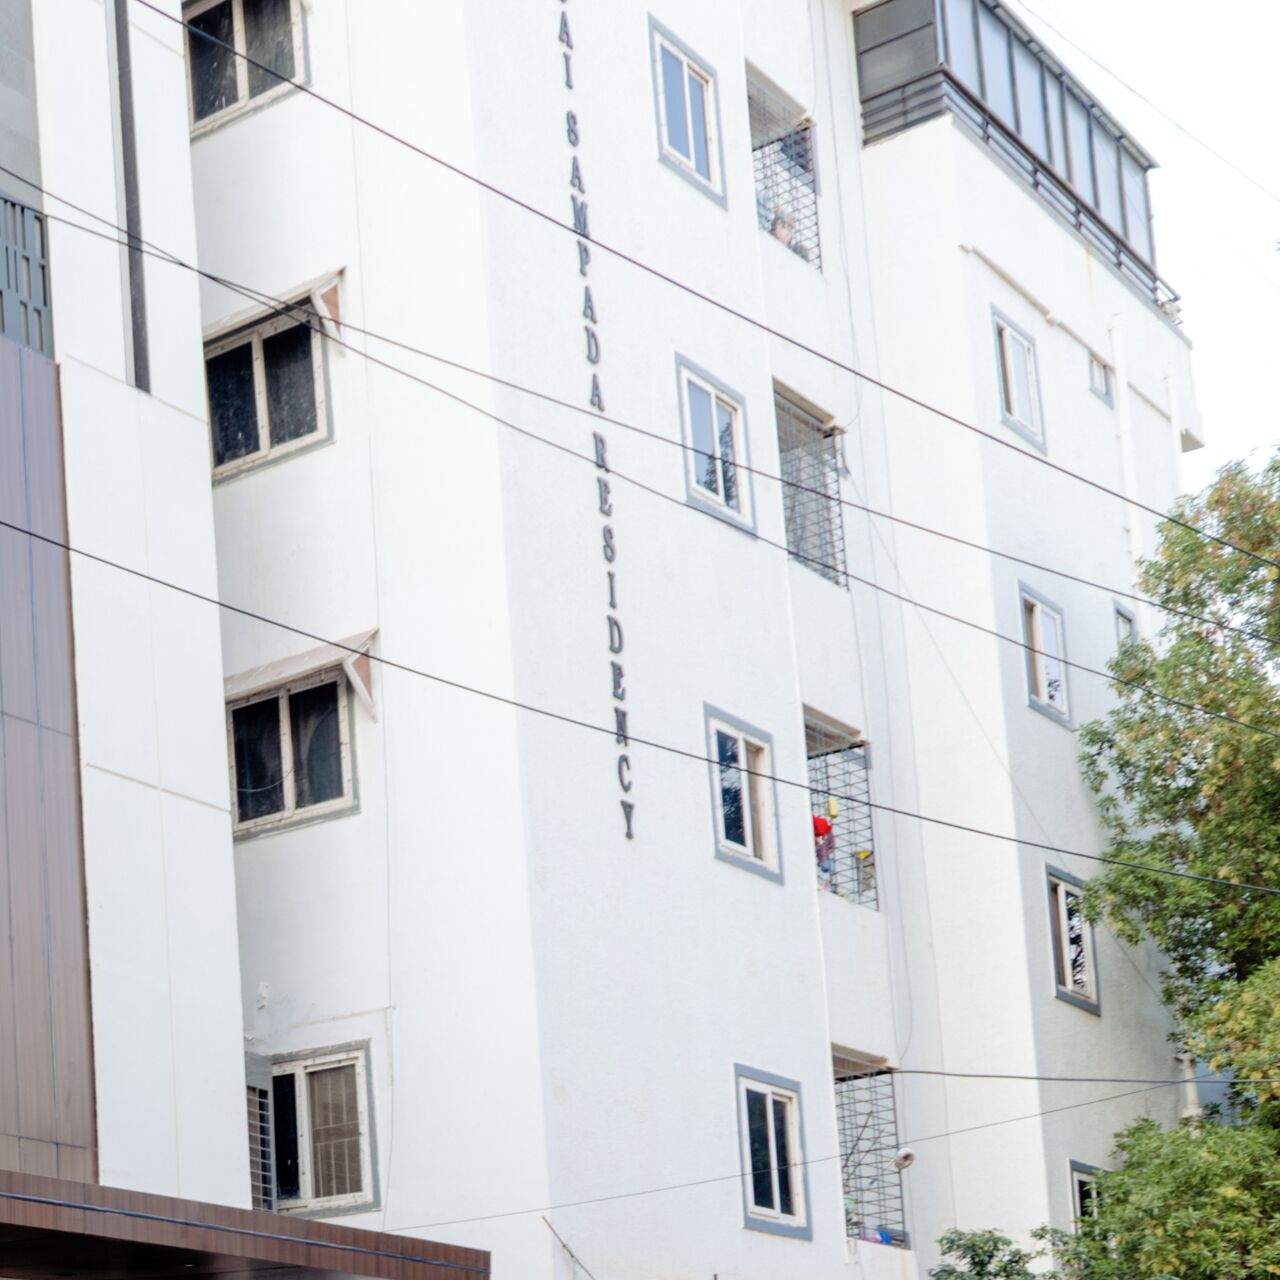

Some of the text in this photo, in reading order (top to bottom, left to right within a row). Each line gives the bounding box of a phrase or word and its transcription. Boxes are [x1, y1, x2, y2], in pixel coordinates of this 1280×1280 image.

[558, 0, 635, 840] AI SAMPADA RESIDENCY
